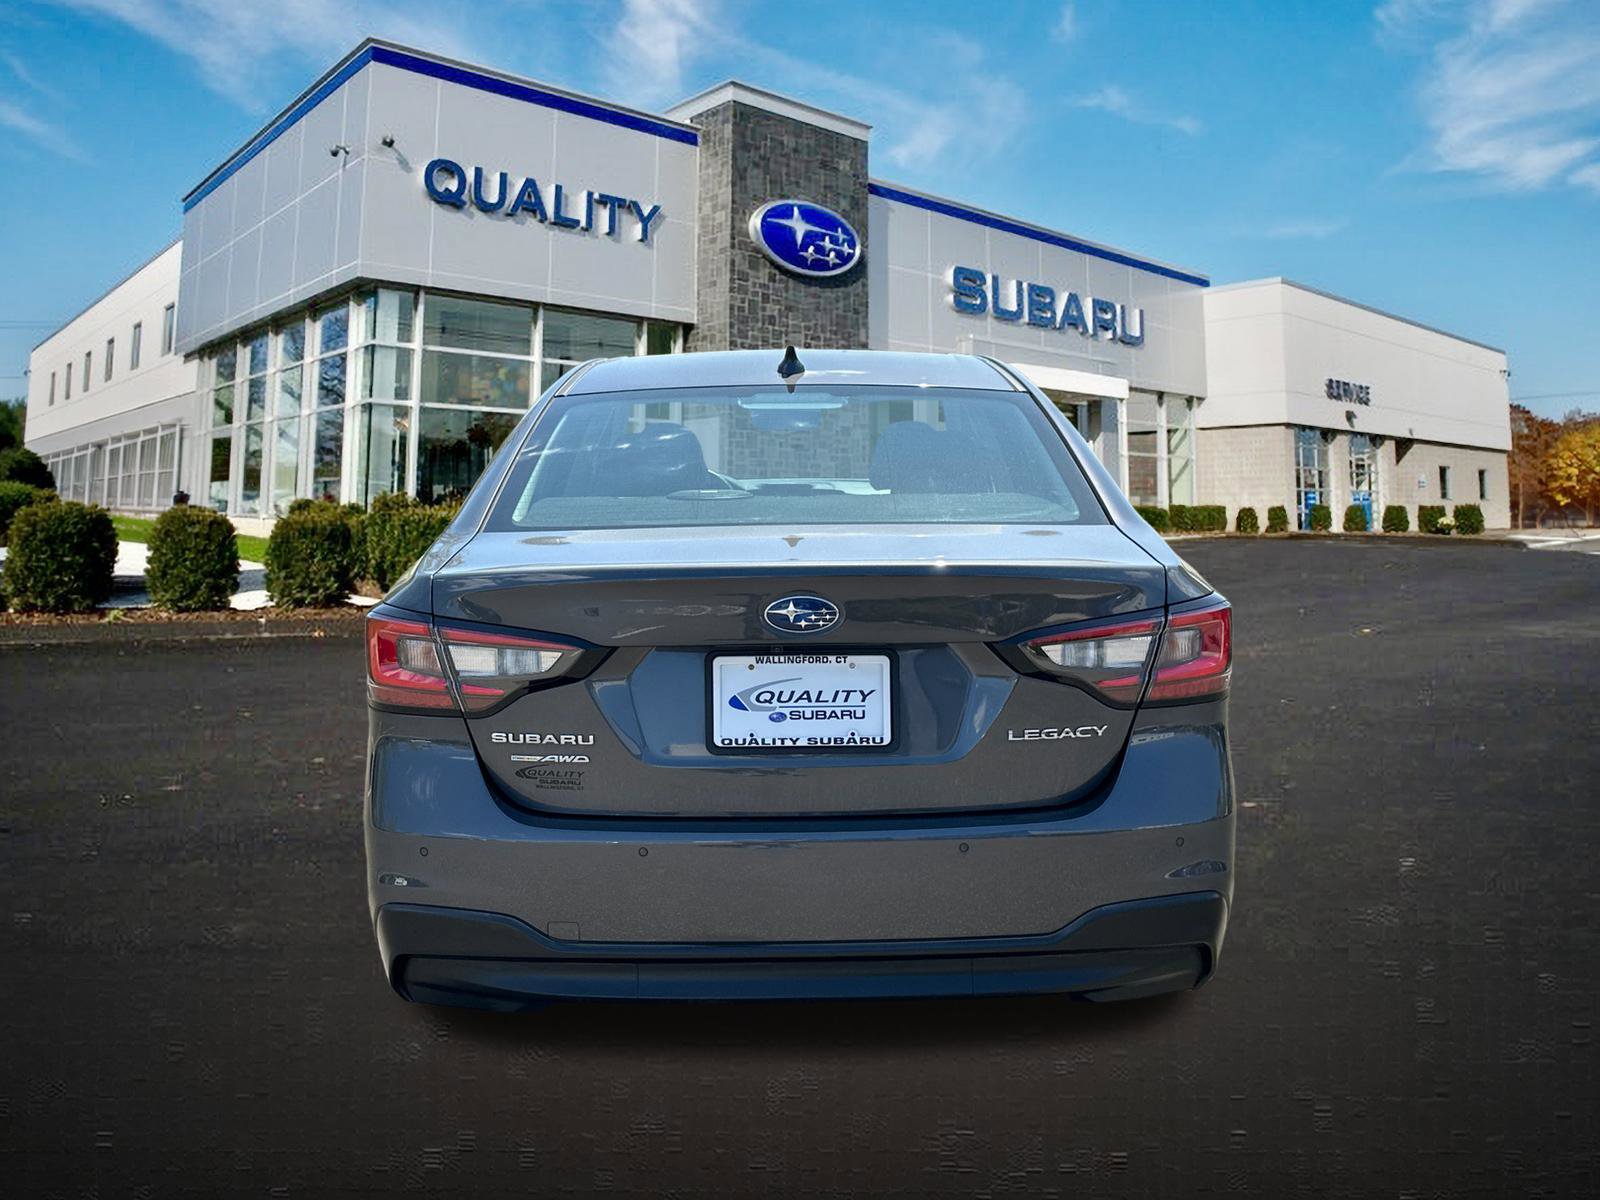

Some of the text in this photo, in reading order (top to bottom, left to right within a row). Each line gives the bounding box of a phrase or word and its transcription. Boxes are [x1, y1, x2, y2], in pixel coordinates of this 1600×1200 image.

[424, 158, 662, 243] QUALITY
[951, 265, 1145, 346] SUBARU
[1325, 378, 1371, 406] SERVICE
[755, 655, 849, 665] WALLINGFORD, CT
[754, 689, 876, 704] QUALITY
[789, 709, 866, 720] SUBARU
[491, 732, 594, 745] SUBARU
[1008, 725, 1108, 741] LEGACY
[720, 736, 884, 746] QUALITY SUBARU
[540, 754, 590, 763] AWD
[527, 769, 584, 779] QUALITY
